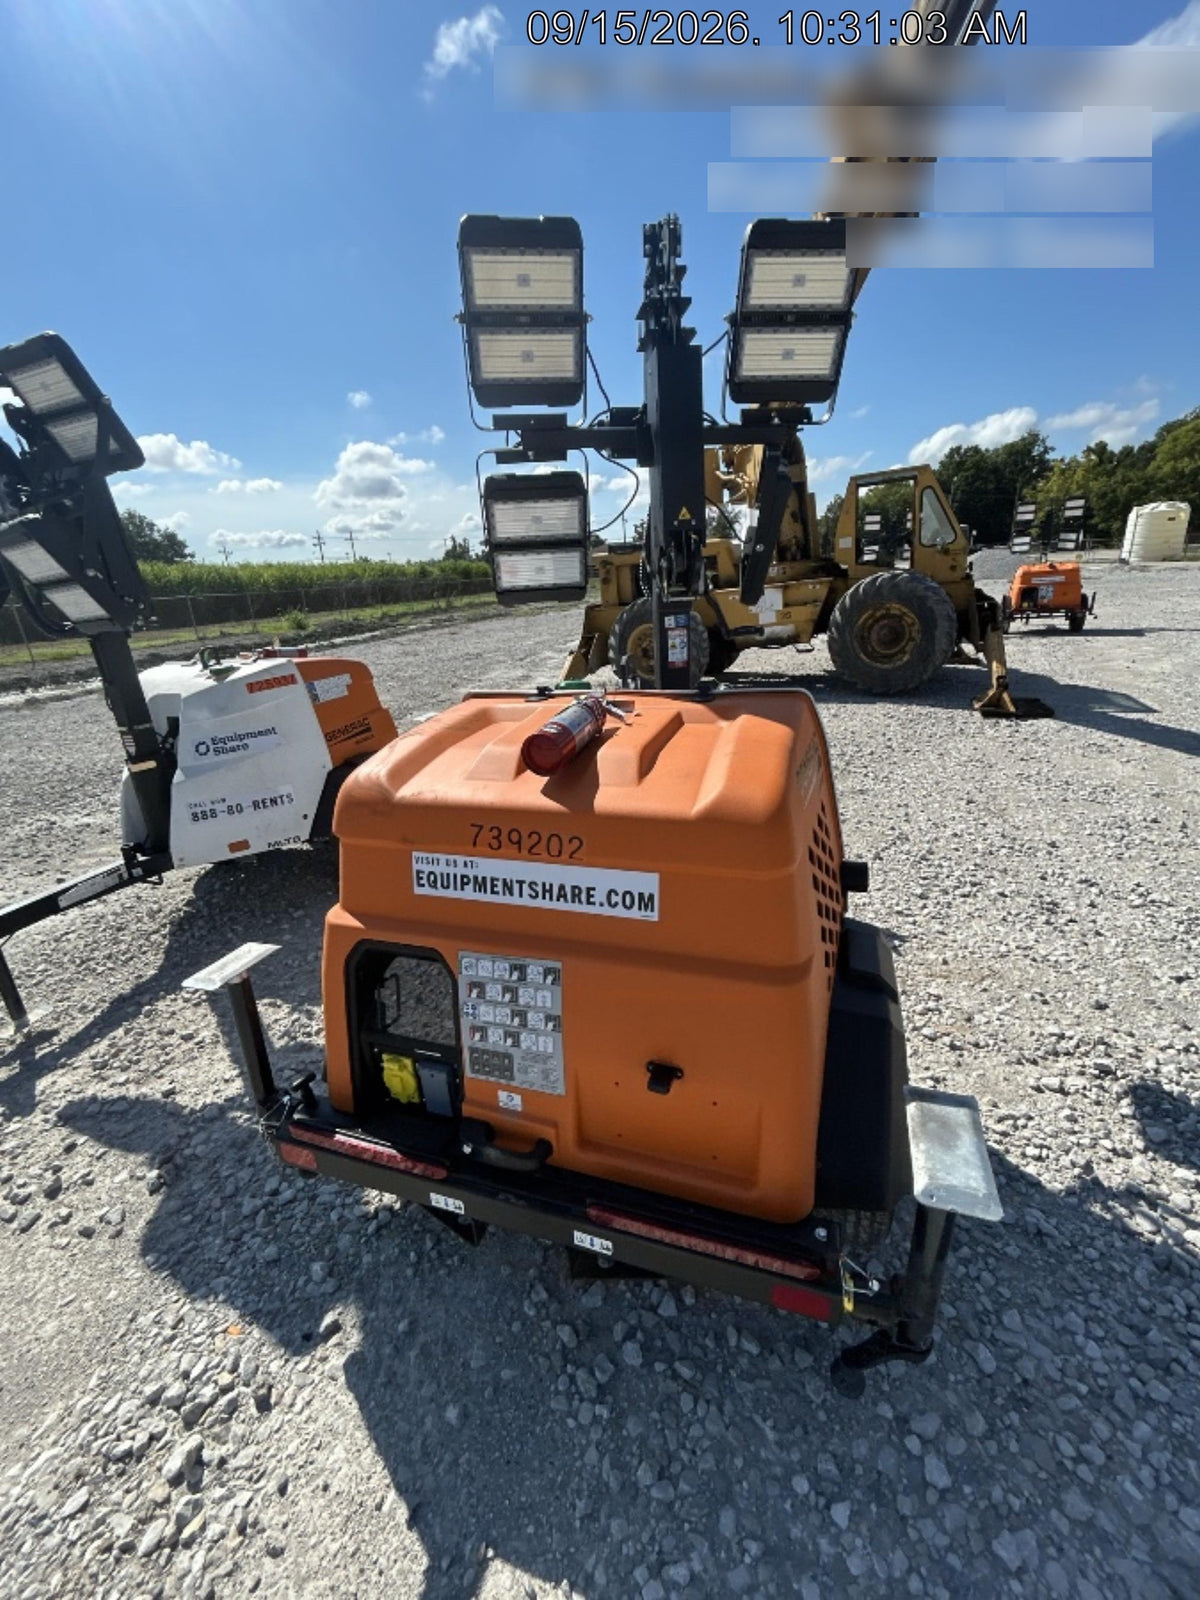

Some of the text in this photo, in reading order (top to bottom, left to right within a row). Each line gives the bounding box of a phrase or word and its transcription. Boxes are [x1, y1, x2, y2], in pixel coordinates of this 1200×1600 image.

[211, 726, 278, 746] Equipment
[212, 742, 249, 756] Share
[191, 793, 294, 821] 888-80-RENTS
[469, 823, 584, 861] 739202
[414, 856, 440, 866] VISIT
[445, 858, 458, 868] US
[415, 869, 656, 913] EQUIPMENTSHARE.COM
